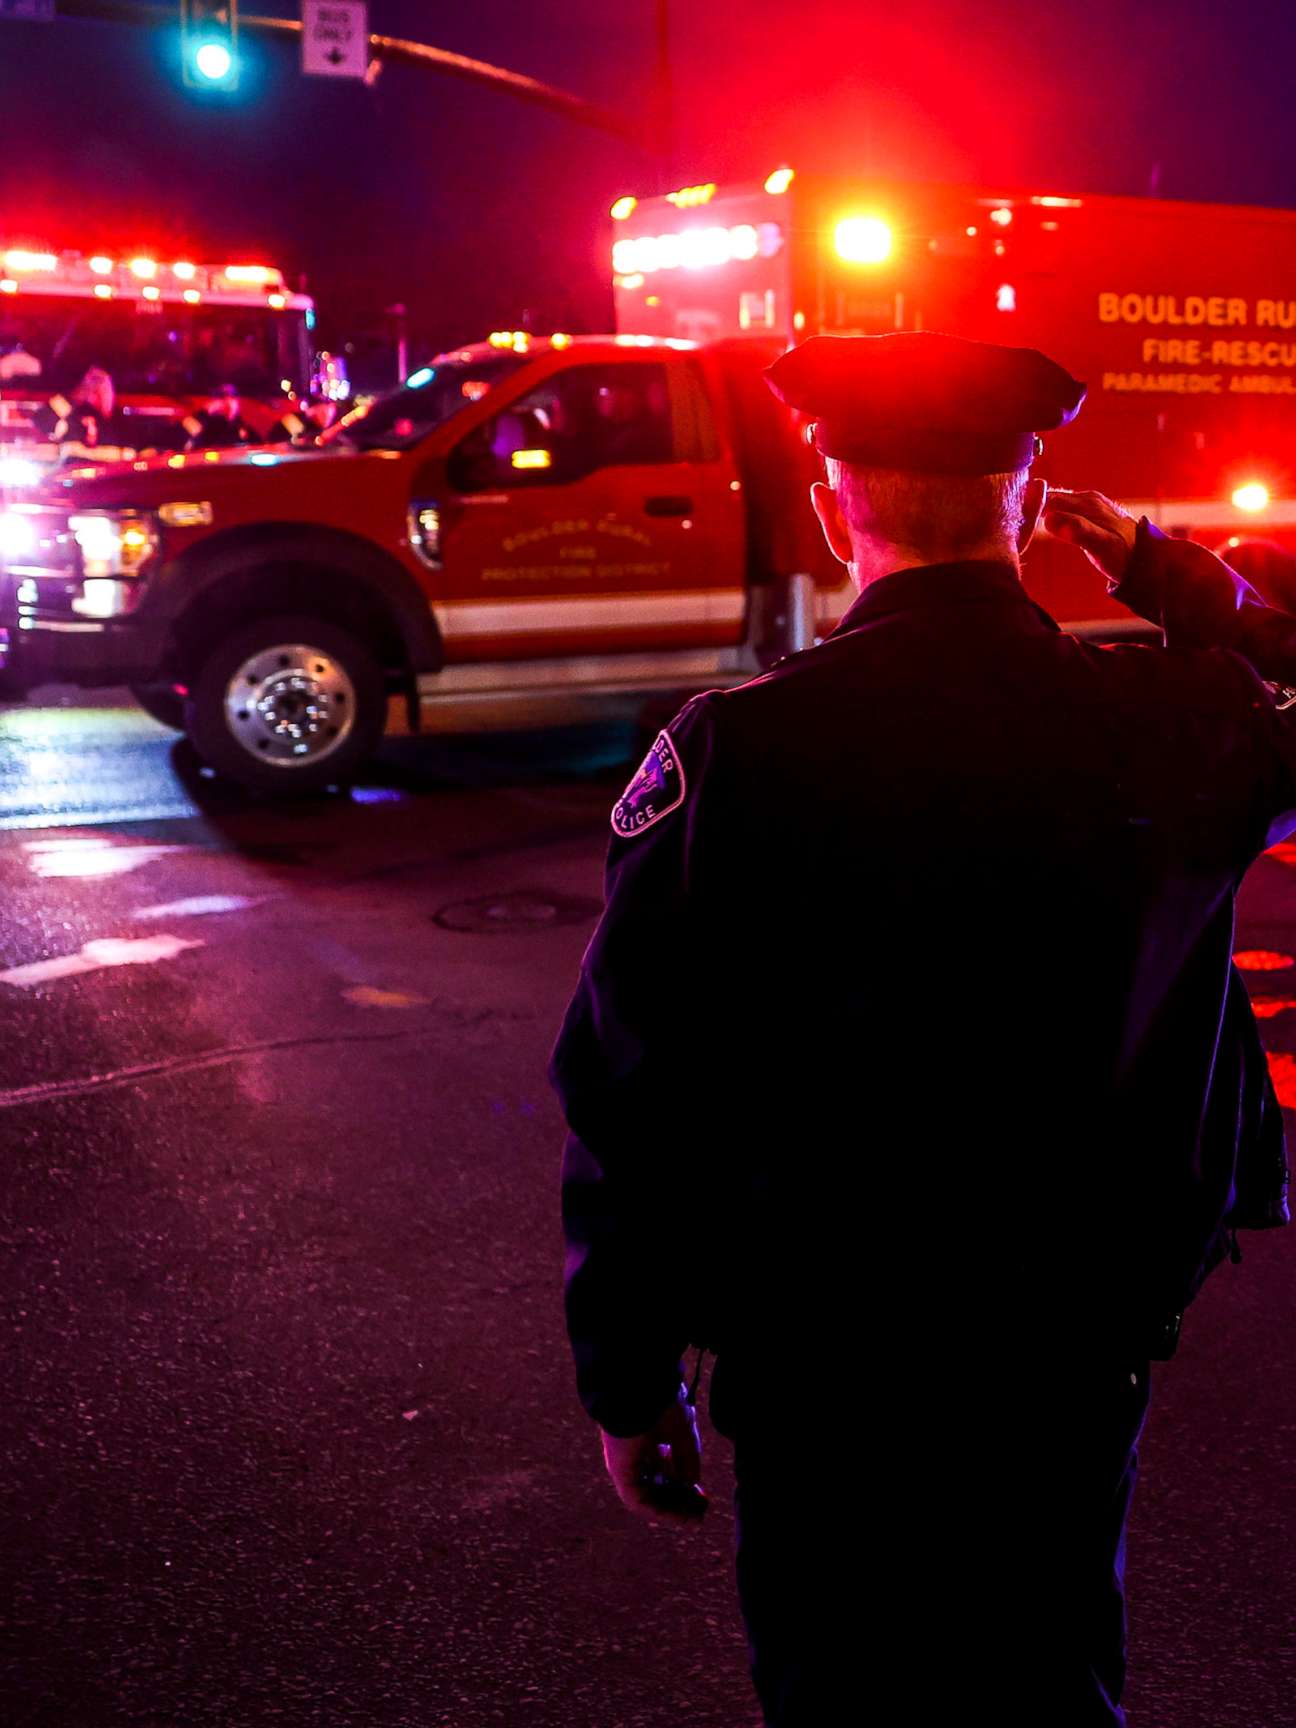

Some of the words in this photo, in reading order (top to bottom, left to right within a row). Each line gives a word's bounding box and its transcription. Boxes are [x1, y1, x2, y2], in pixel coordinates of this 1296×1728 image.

[1098, 292, 1247, 326] BOULDER
[1102, 372, 1223, 394] PARAMEDIC
[502, 518, 590, 552] BOULDER
